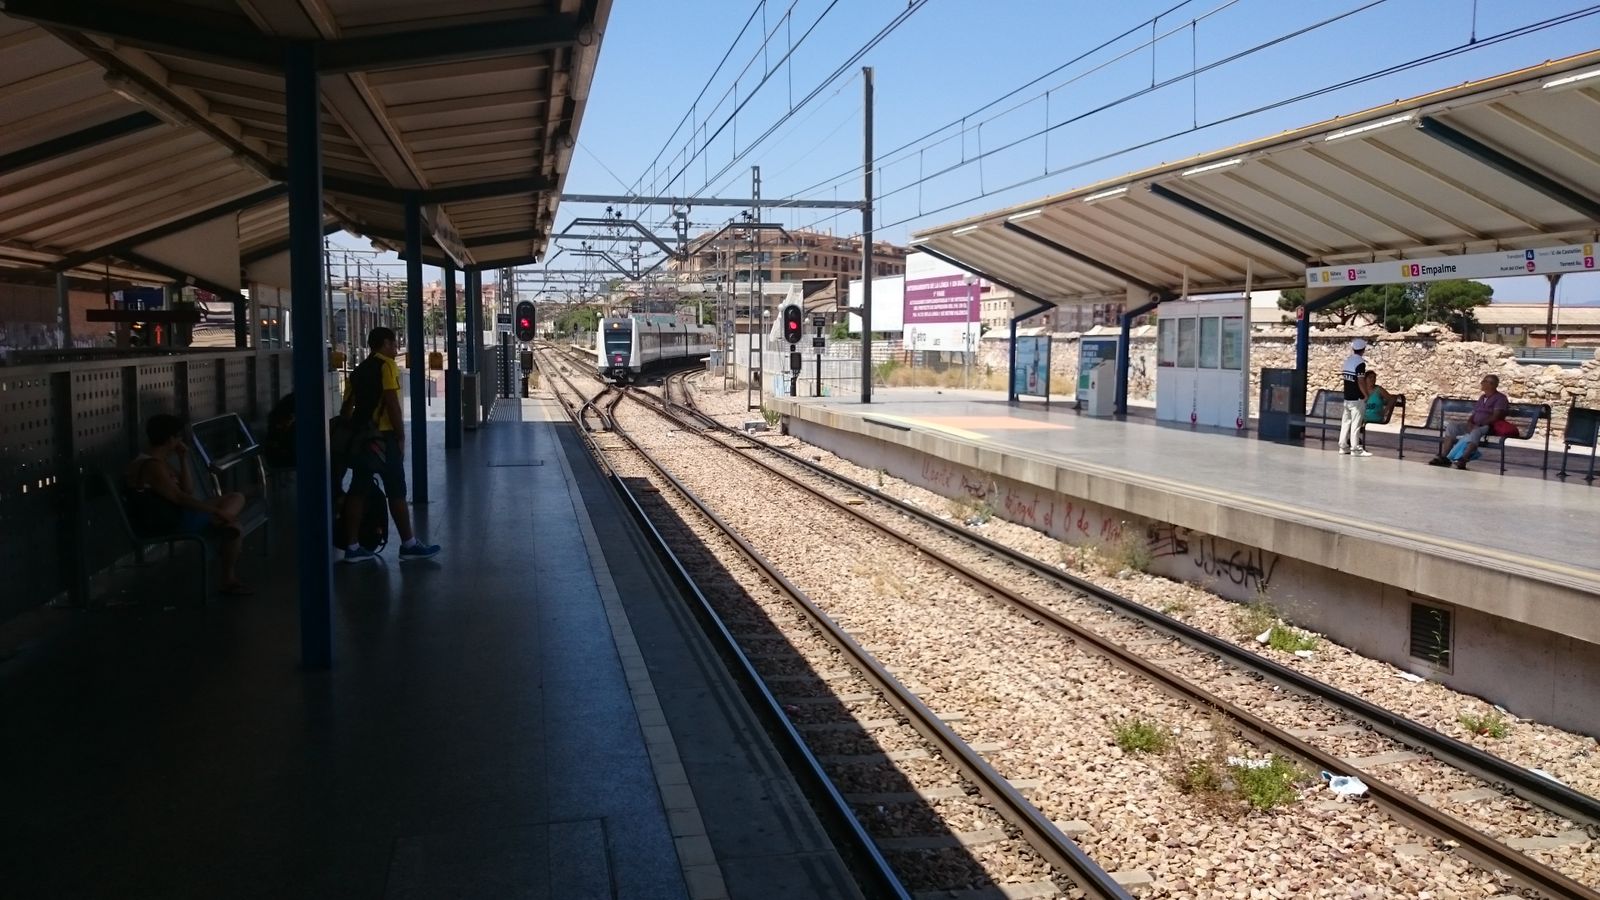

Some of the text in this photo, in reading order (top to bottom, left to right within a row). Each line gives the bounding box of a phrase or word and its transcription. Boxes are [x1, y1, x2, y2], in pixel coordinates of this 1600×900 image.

[1421, 264, 1457, 276] Empalme
[1043, 502, 1055, 529] el
[1063, 502, 1073, 532] 8
[1076, 508, 1090, 537] de
